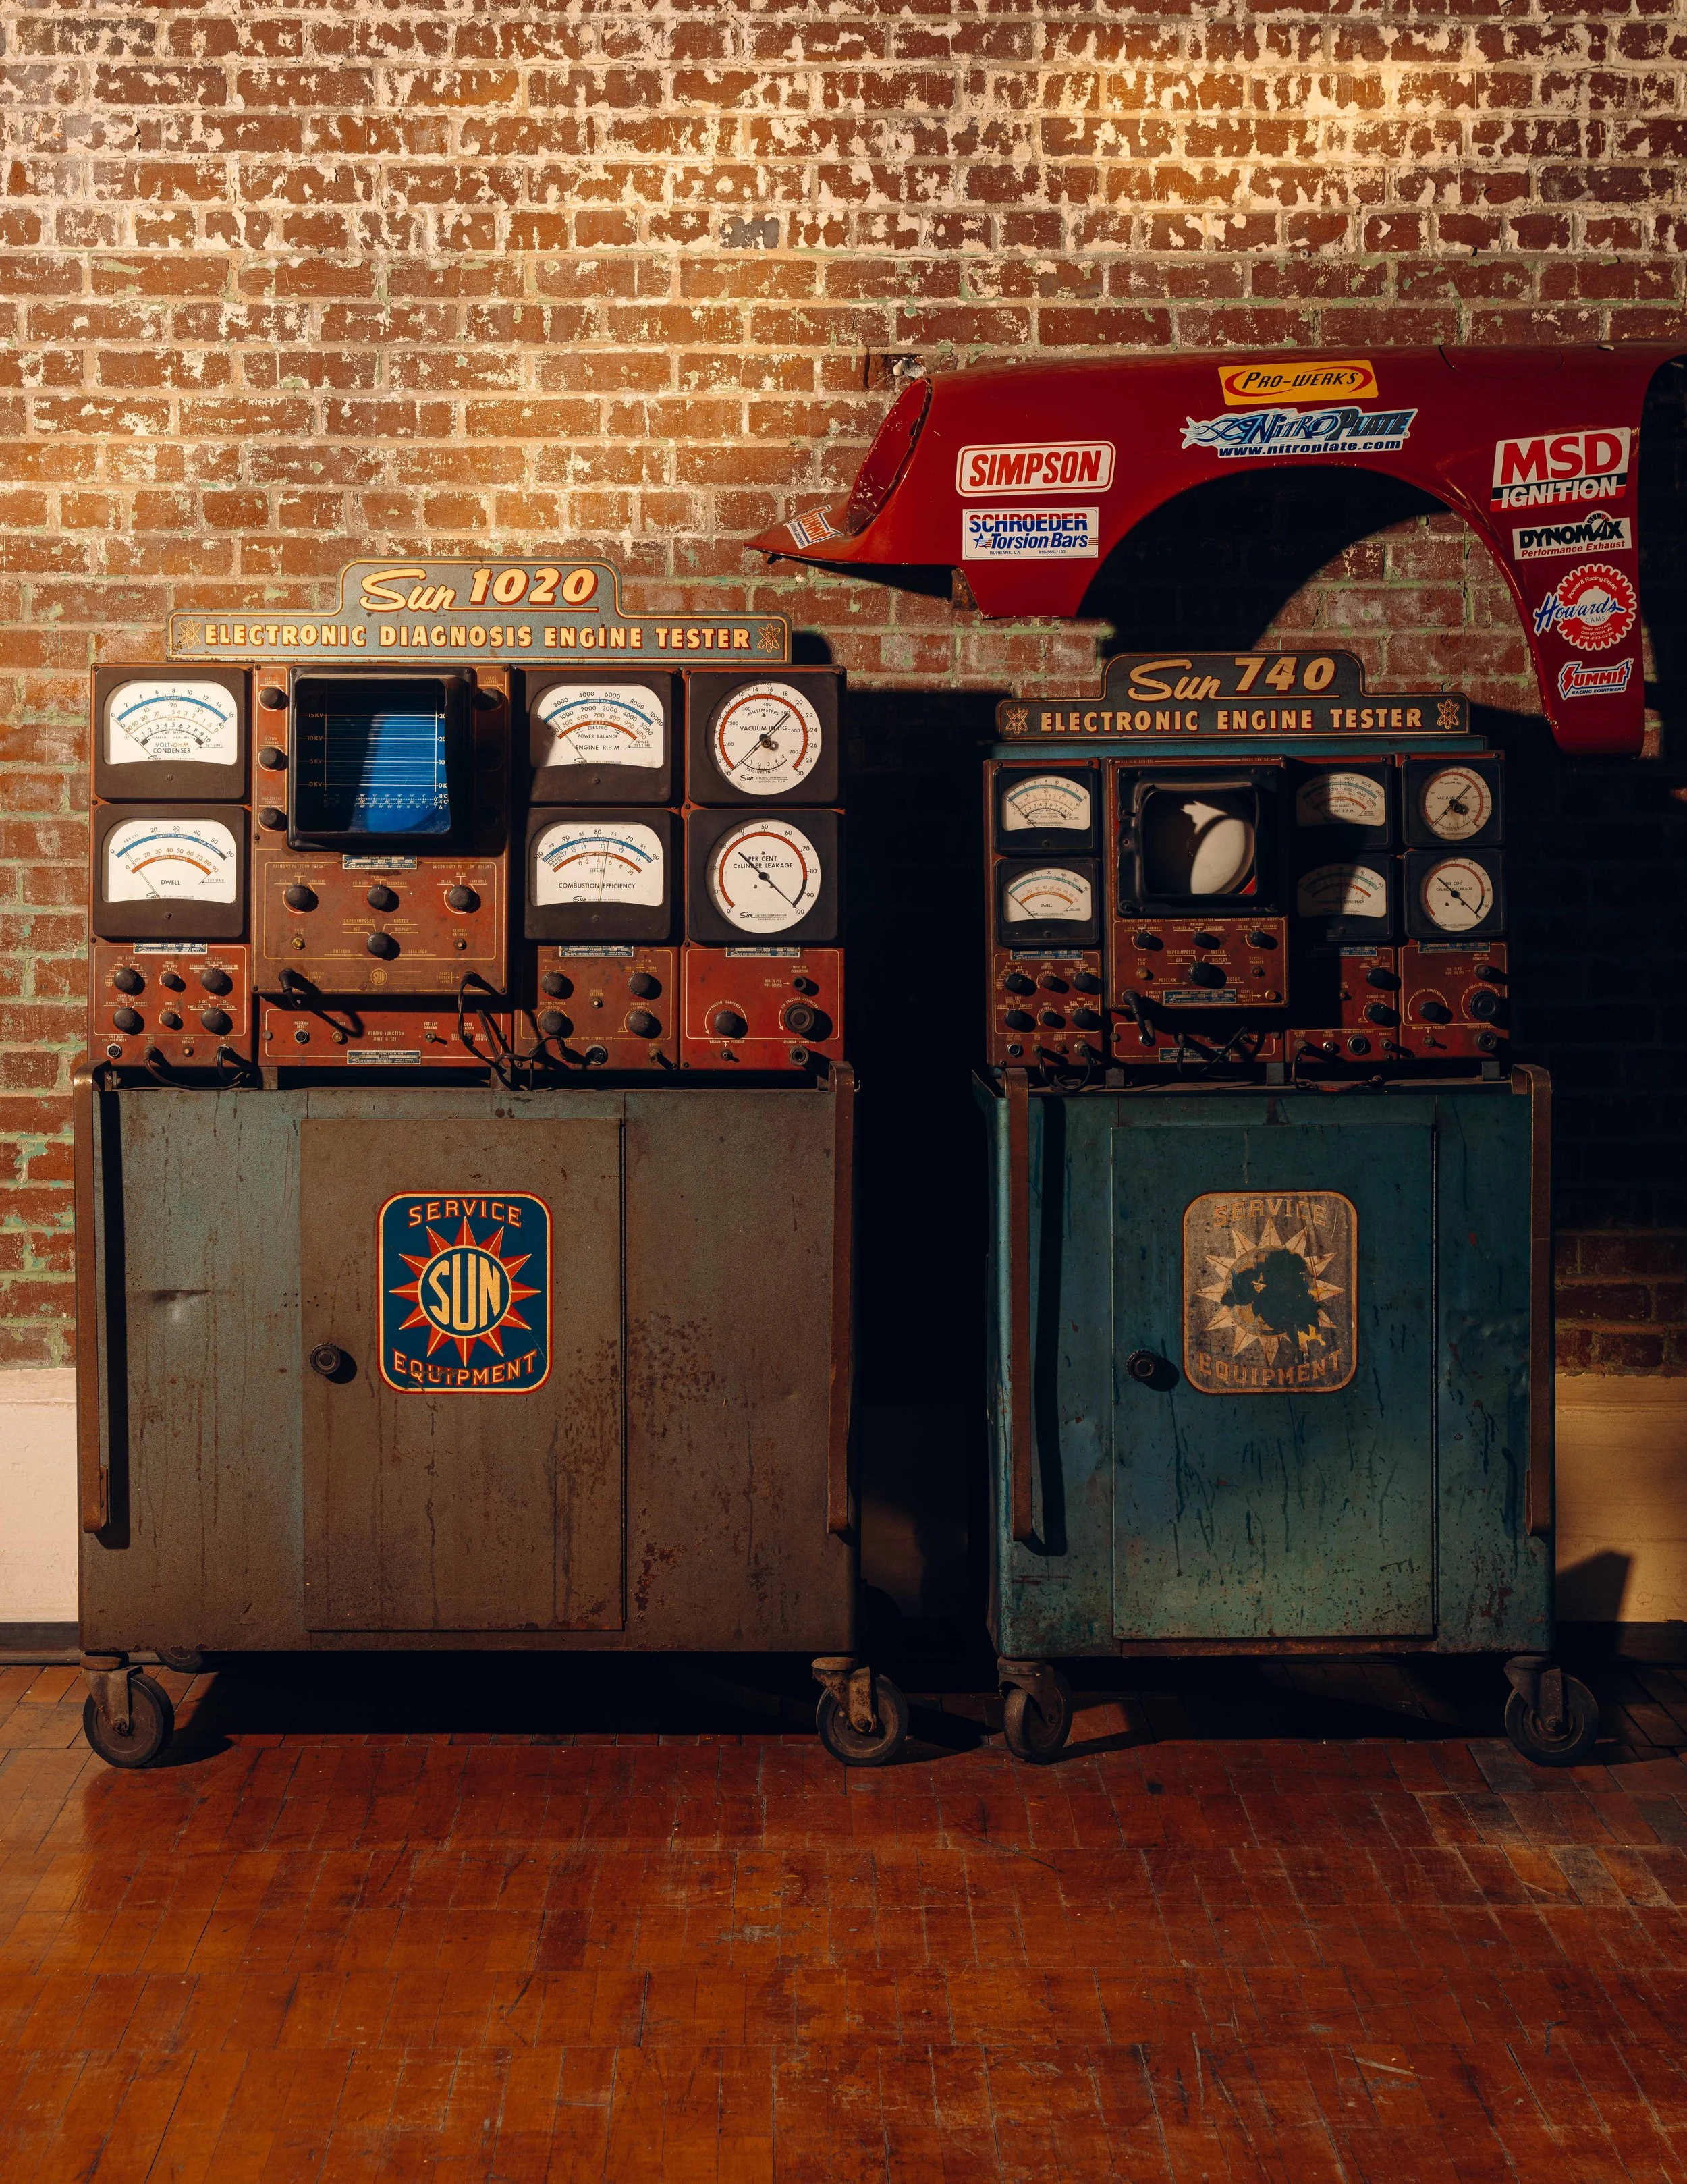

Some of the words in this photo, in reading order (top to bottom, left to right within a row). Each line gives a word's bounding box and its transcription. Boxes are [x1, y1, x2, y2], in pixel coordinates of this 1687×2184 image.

[1219, 440, 1401, 456] www.nitroplate.com
[1501, 433, 1622, 485] MSD
[969, 450, 1101, 487] SIMPSON
[1501, 476, 1617, 508] IGNITION
[969, 513, 1088, 533] SCHROEDER
[1519, 518, 1624, 549] DYNOMAX
[991, 533, 1049, 549] Torsion
[1051, 533, 1088, 548] Bars
[1522, 545, 1583, 557] Performance
[1586, 541, 1625, 551] Exhaust
[360, 568, 456, 613] Sun
[470, 568, 599, 606] 1020
[1568, 582, 1580, 599] Power
[1603, 578, 1617, 592] Equip.
[1534, 594, 1626, 632] Howards
[204, 624, 366, 647] ELECTRONIC
[379, 624, 532, 649] DIAGNOSIS
[544, 626, 642, 649] ENGINE
[655, 628, 751, 649] TESTER
[1128, 659, 1221, 701] Sun
[1234, 657, 1337, 694] 740
[553, 697, 569, 707] 2000
[630, 699, 644, 709] 8000
[649, 711, 663, 727] 10000
[560, 711, 574, 719] 1000
[623, 711, 638, 721] 4000
[640, 723, 653, 736] 5000
[748, 708, 779, 716] MILLIMETERS
[1041, 711, 1200, 732] ELECTRONIC
[1217, 710, 1313, 732] ENGINE
[1330, 708, 1422, 729] TESTER
[534, 851, 543, 860] 100
[373, 971, 385, 983] SUN
[408, 1199, 522, 1228] SERVICE
[1214, 1199, 1327, 1228] SERVICE
[428, 1253, 501, 1331] SUN
[392, 1348, 537, 1386] EQUIPMENT
[1198, 1348, 1342, 1386] EQUIPMENT
